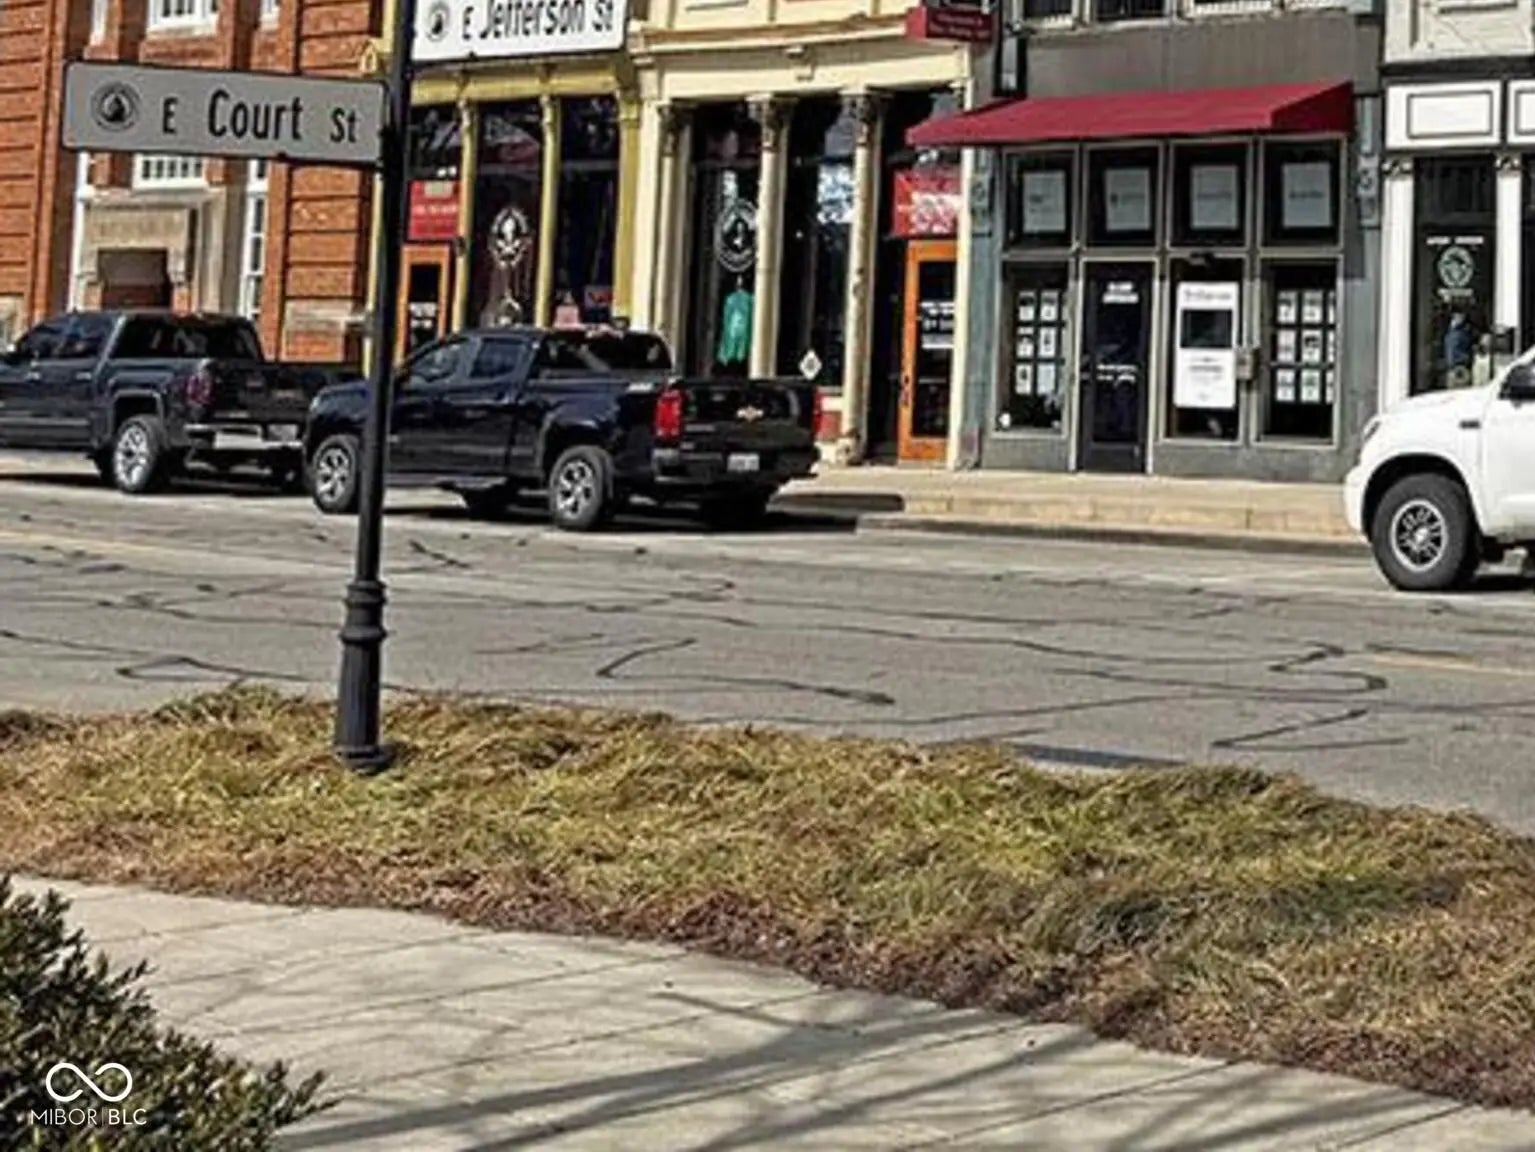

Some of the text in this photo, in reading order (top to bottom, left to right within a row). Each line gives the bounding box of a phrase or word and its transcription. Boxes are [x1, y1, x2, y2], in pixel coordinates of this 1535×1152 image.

[461, 5, 474, 41] E
[162, 88, 357, 144] E Court St
